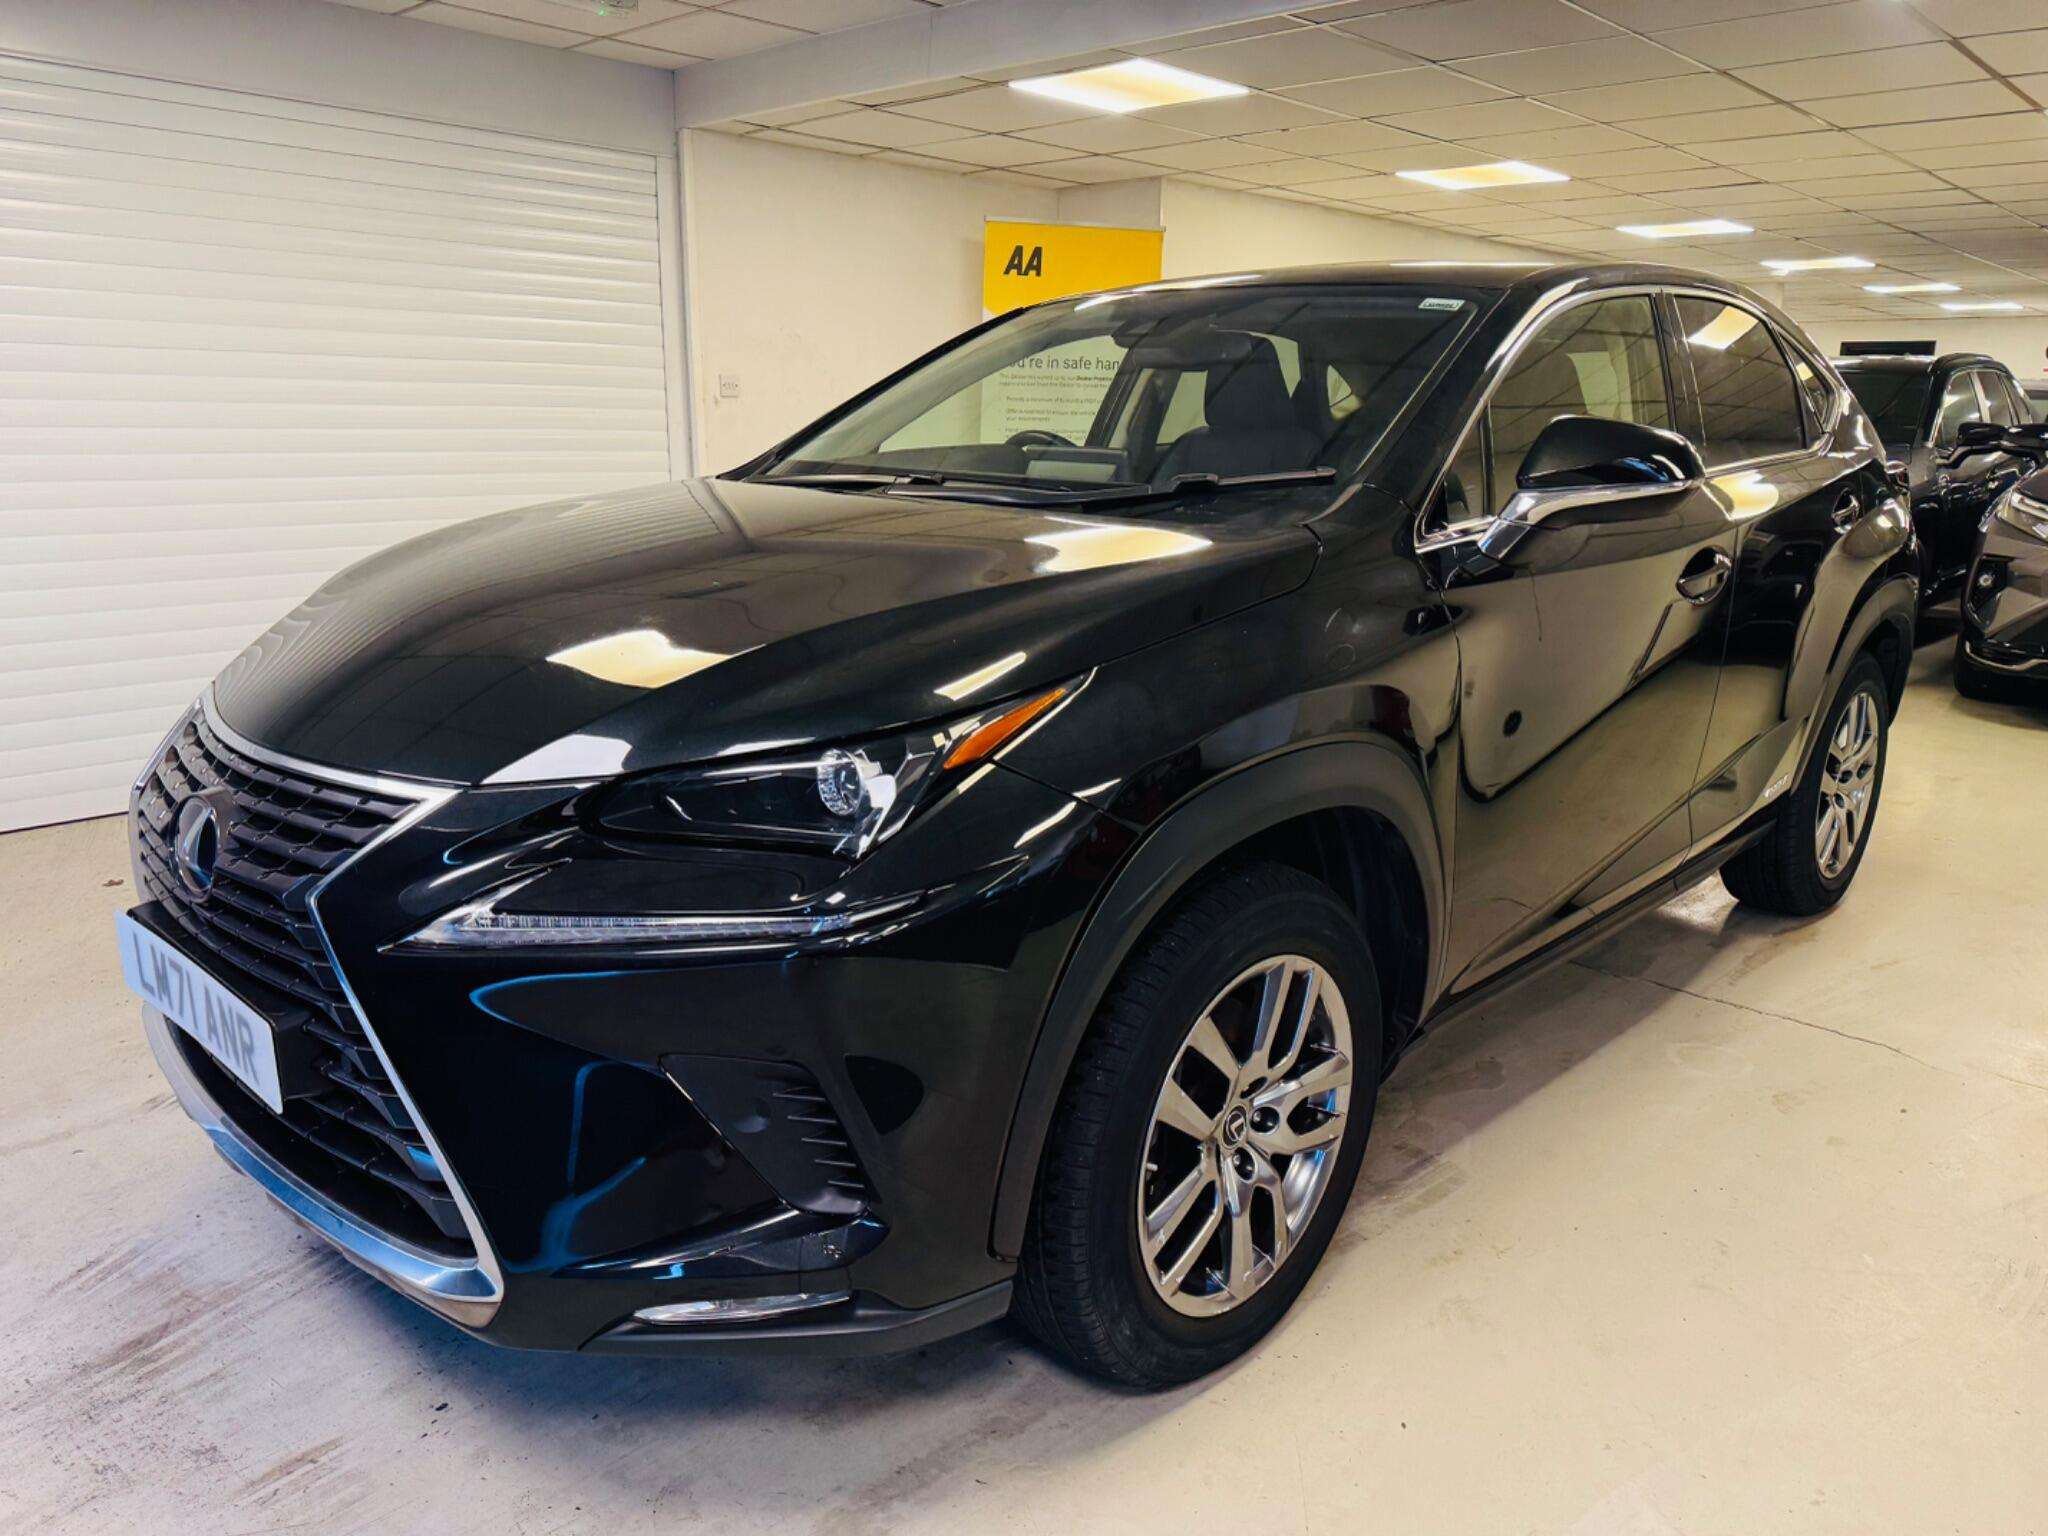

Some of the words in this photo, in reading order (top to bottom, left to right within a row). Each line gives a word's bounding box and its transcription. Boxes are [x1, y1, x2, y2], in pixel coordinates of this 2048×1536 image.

[1003, 245, 1042, 276] AA
[1047, 355, 1060, 369] in
[1063, 355, 1092, 370] safe
[204, 985, 260, 1087] ANR
